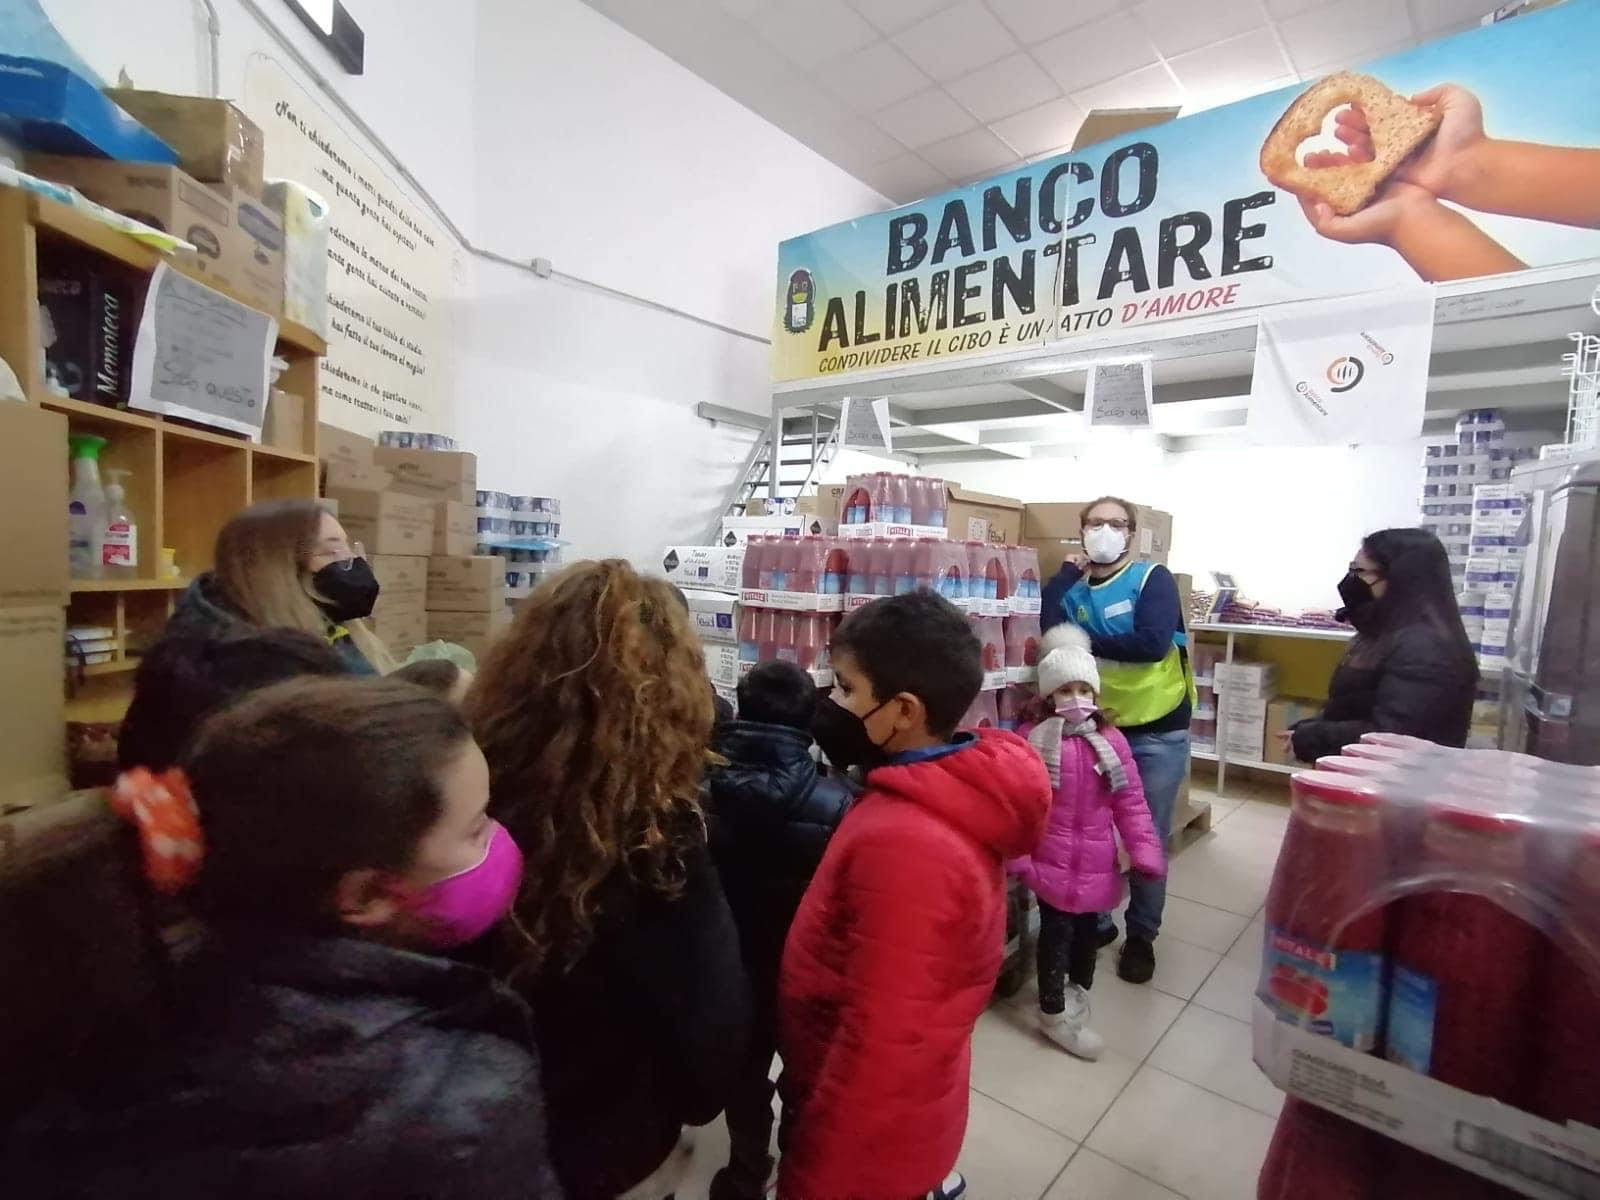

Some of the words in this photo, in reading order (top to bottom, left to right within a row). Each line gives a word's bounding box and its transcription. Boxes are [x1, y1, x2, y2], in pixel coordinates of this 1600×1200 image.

[275, 100, 298, 126] Non
[308, 129, 351, 175] chiederemo
[361, 202, 380, 222] gente
[887, 141, 1159, 275] BANCO
[817, 191, 1276, 352] ALIMENTARE
[97, 293, 120, 396] Memoteca
[818, 342, 922, 372] CONDIVIDERE
[926, 339, 941, 357] IL
[948, 330, 992, 353] CIBO
[999, 322, 1011, 344] È
[1017, 318, 1045, 341] UN
[1061, 307, 1113, 332] ATTO
[1121, 284, 1240, 324] D'AMORE
